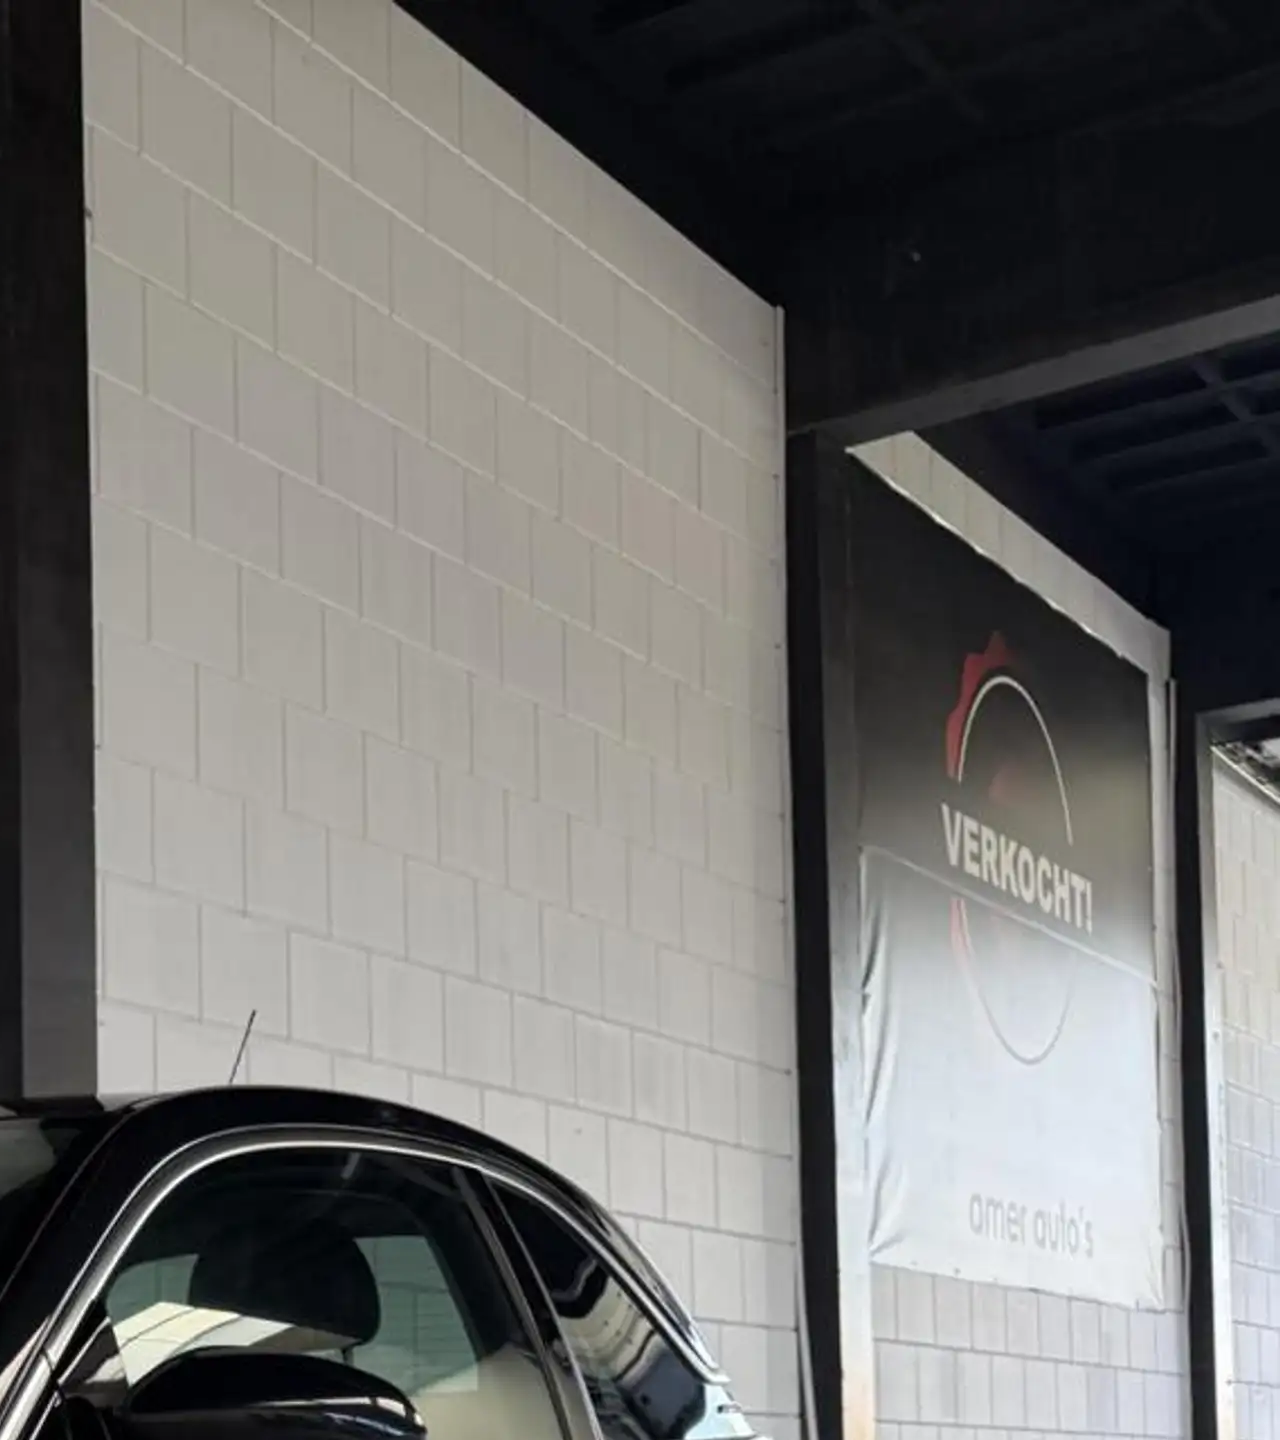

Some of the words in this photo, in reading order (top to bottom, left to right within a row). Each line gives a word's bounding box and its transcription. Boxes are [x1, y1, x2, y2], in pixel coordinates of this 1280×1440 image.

[940, 802, 1093, 936] VERKOCHT!
[969, 1192, 1028, 1246] amer
[1033, 1197, 1094, 1259] auto's
